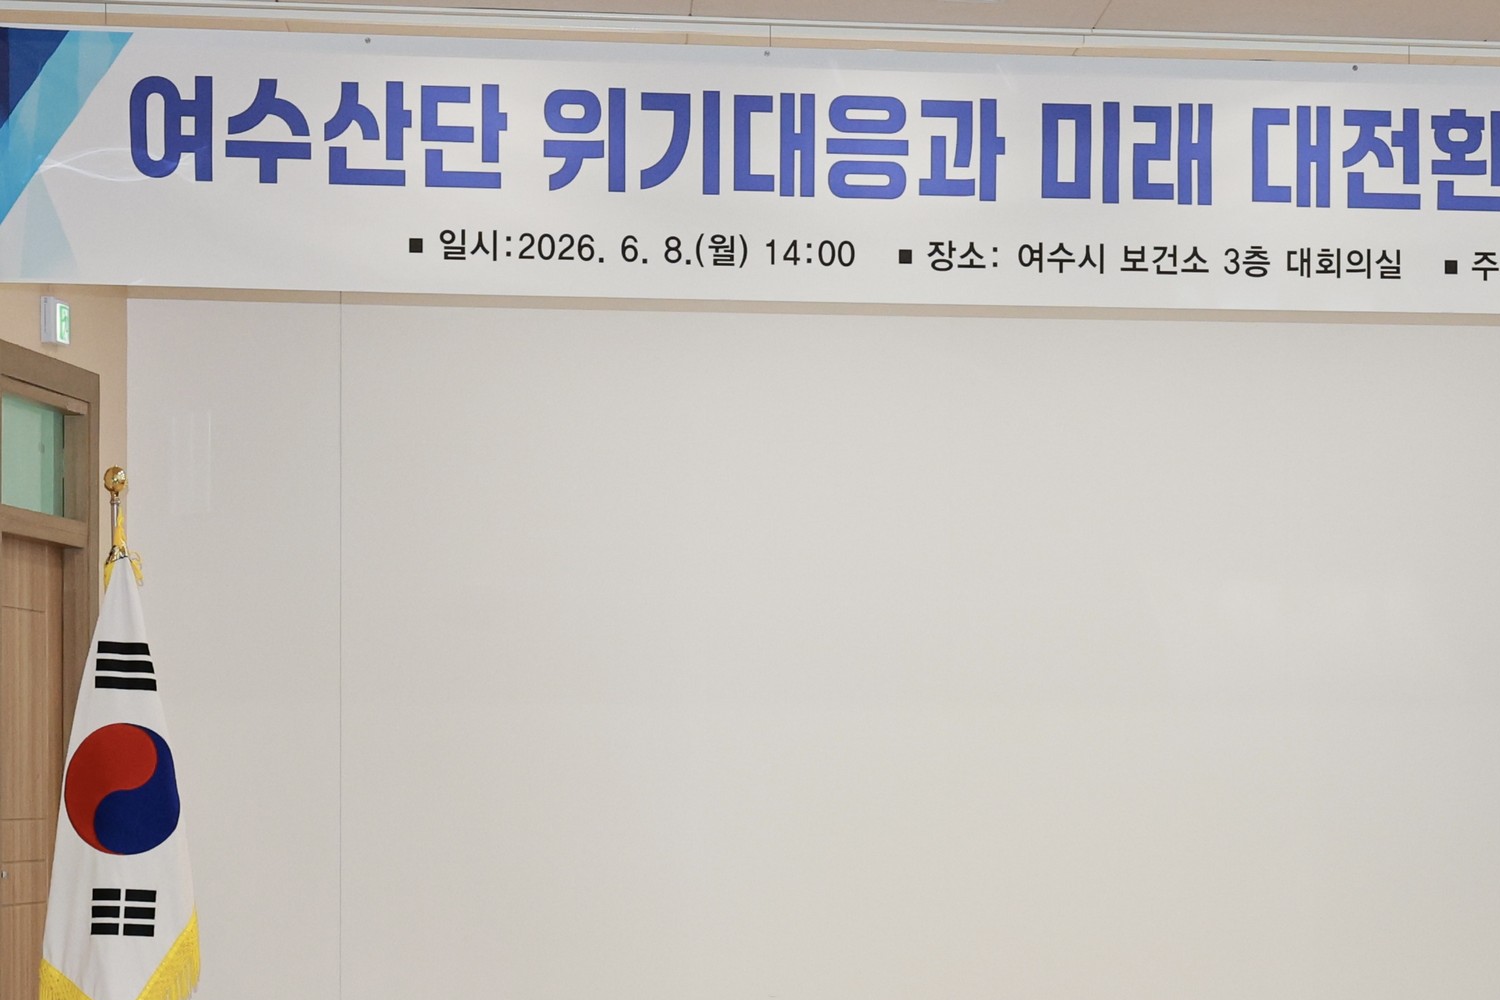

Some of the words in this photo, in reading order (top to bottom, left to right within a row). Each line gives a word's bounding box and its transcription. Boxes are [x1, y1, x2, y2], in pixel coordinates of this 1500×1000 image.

[129, 75, 508, 189] 여수산단
[543, 86, 1007, 203] 위기대응과
[1041, 101, 1214, 207] 미래
[620, 234, 649, 264] 6.
[663, 233, 749, 269] 8.(월)
[764, 239, 857, 267] 14:00
[926, 240, 999, 272] 장소:
[1017, 242, 1106, 275] 여수시
[1119, 244, 1211, 276] 보건소
[1222, 245, 1272, 279] 3층
[1285, 247, 1403, 280] 대회의실
